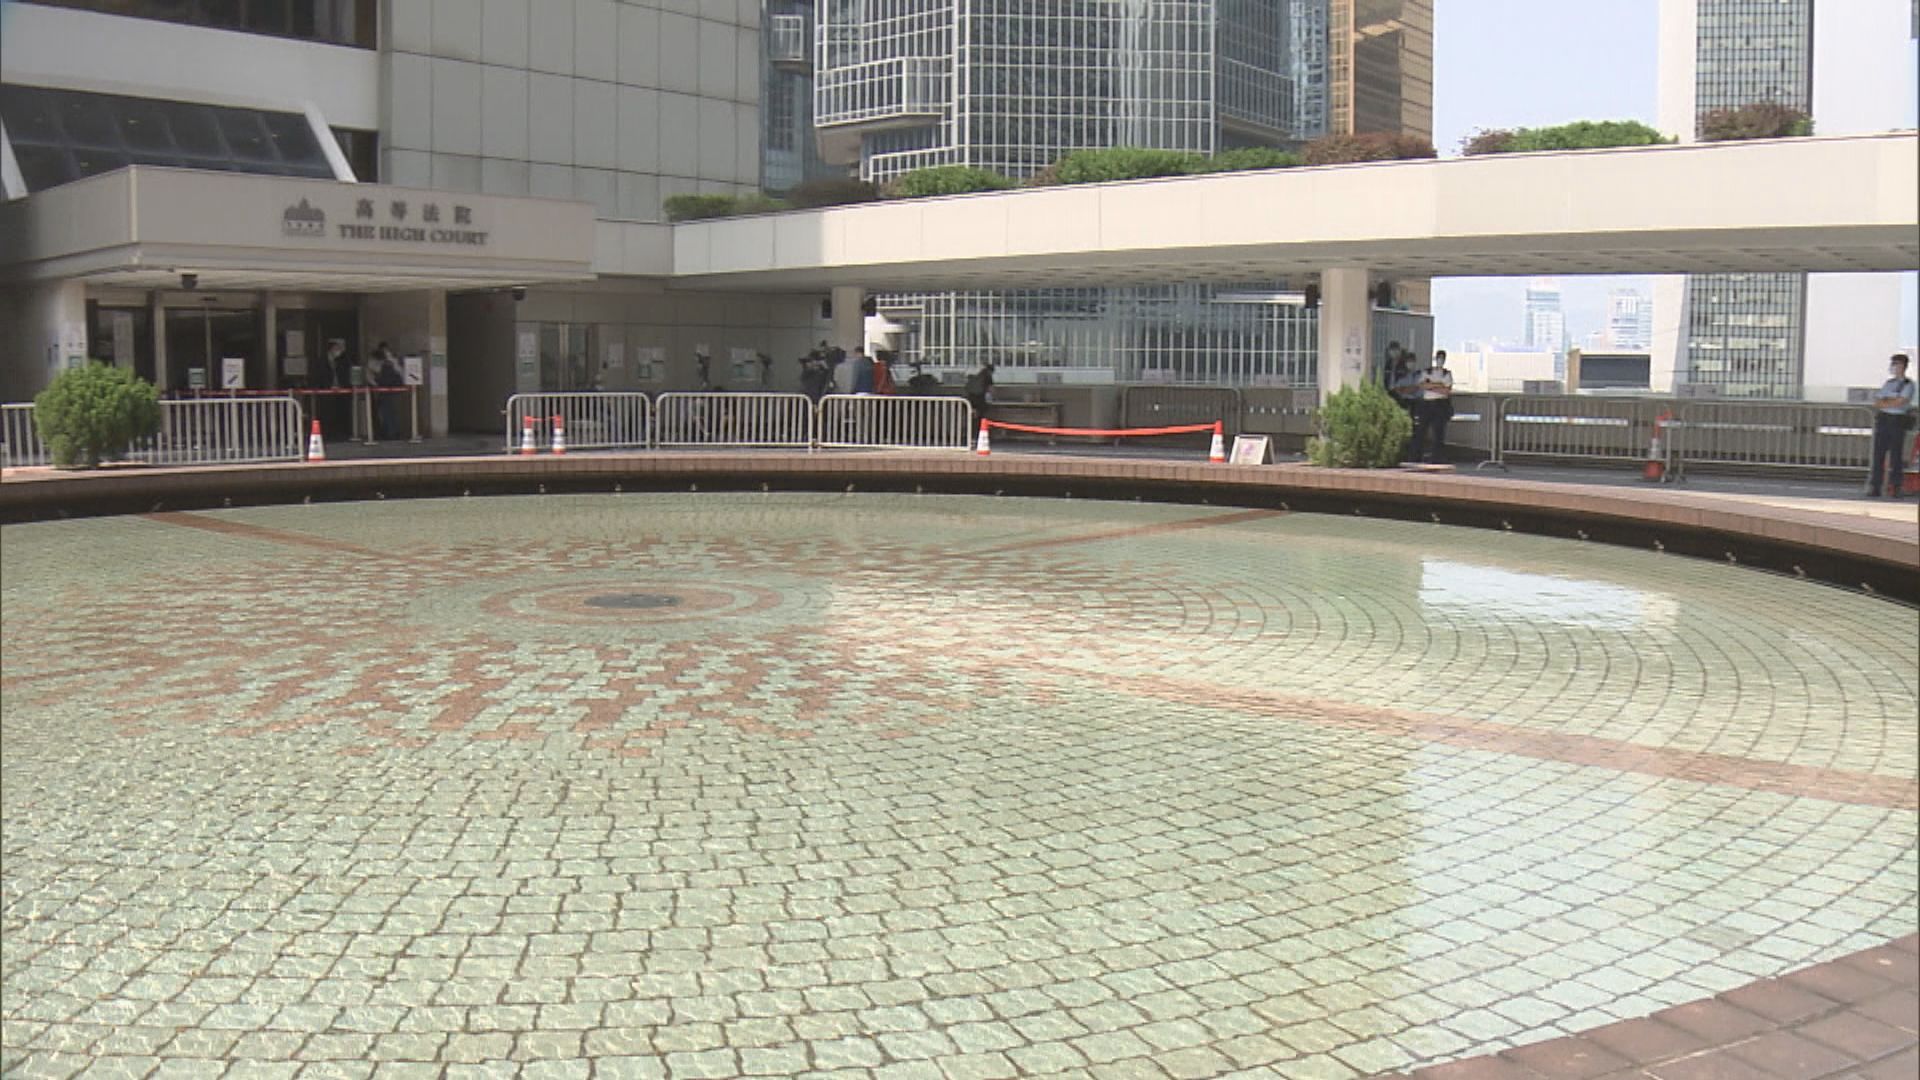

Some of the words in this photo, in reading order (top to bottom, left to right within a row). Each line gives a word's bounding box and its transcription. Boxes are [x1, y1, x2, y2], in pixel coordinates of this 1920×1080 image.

[356, 198, 472, 225] 高等法院
[339, 223, 375, 240] THE
[379, 225, 426, 242] HIGH
[430, 228, 488, 246] COURT
